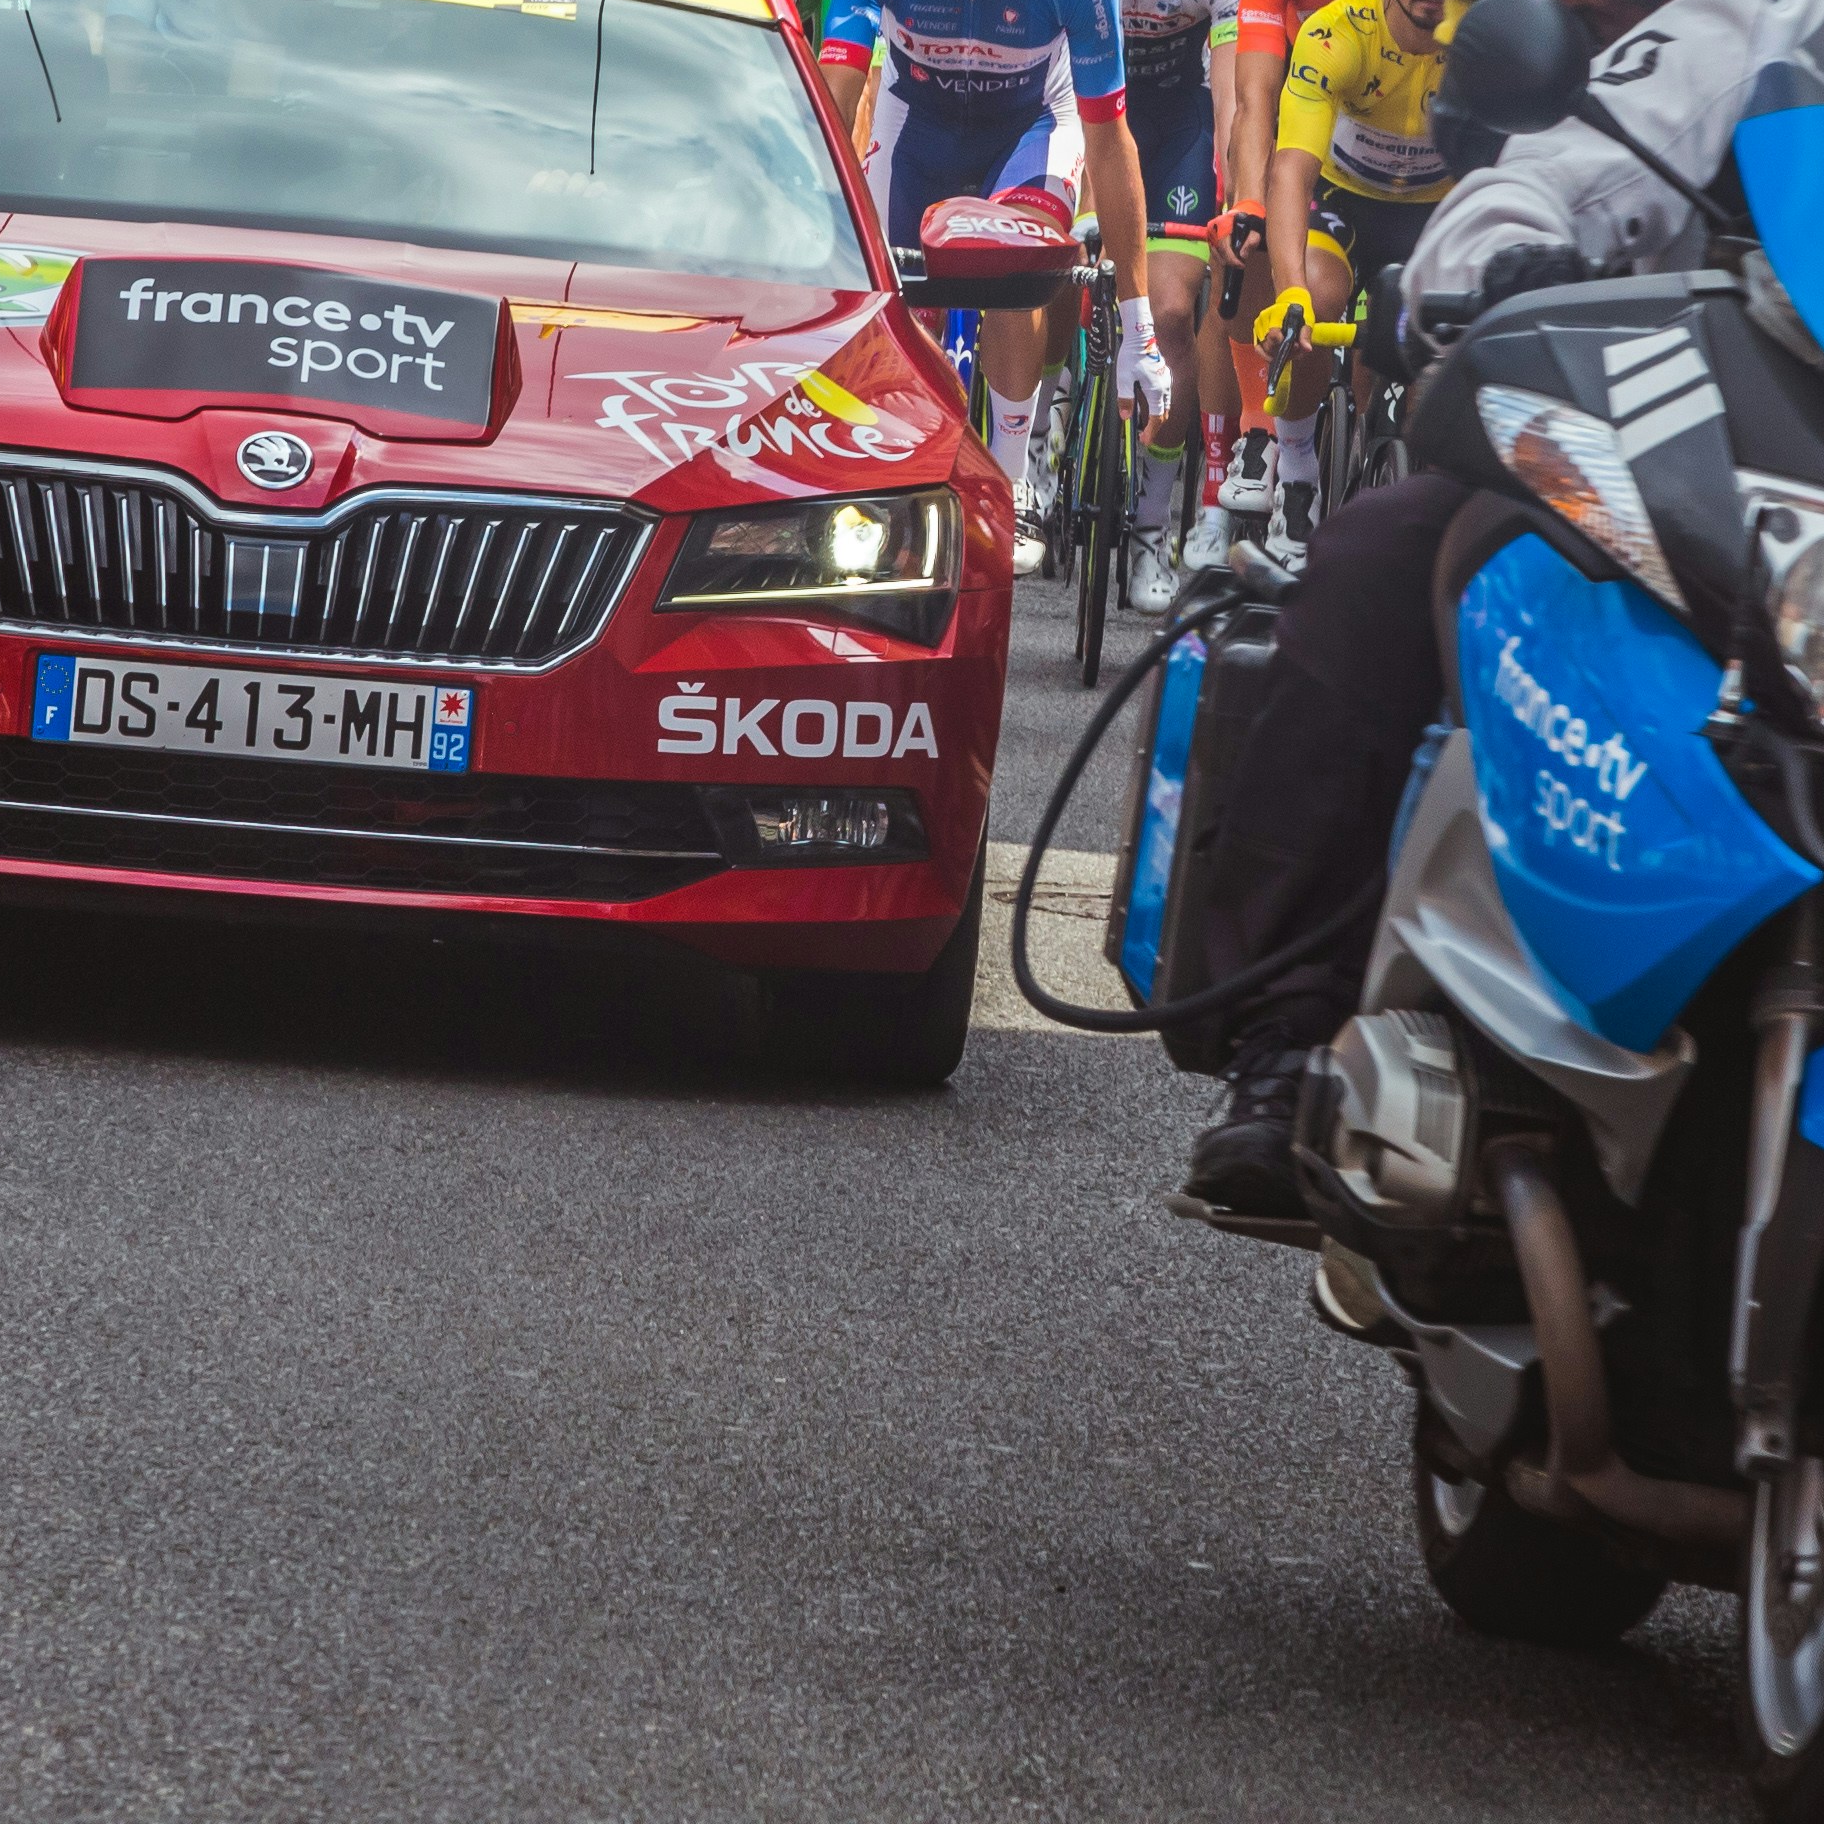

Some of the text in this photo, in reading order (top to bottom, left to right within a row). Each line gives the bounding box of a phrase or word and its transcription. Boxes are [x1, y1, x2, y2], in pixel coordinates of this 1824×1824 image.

[919, 43, 1003, 59] TOTAL
[1381, 46, 1405, 67] LCL
[1291, 62, 1333, 96] LCL
[946, 215, 1067, 244] ŠKODA
[267, 335, 447, 391] sport
[784, 392, 823, 419] de
[45, 705, 58, 725] F
[73, 666, 427, 761] DS-413-MH
[657, 681, 939, 759] ŠKODA
[432, 732, 465, 762] 92
[1532, 768, 1627, 874] sport
